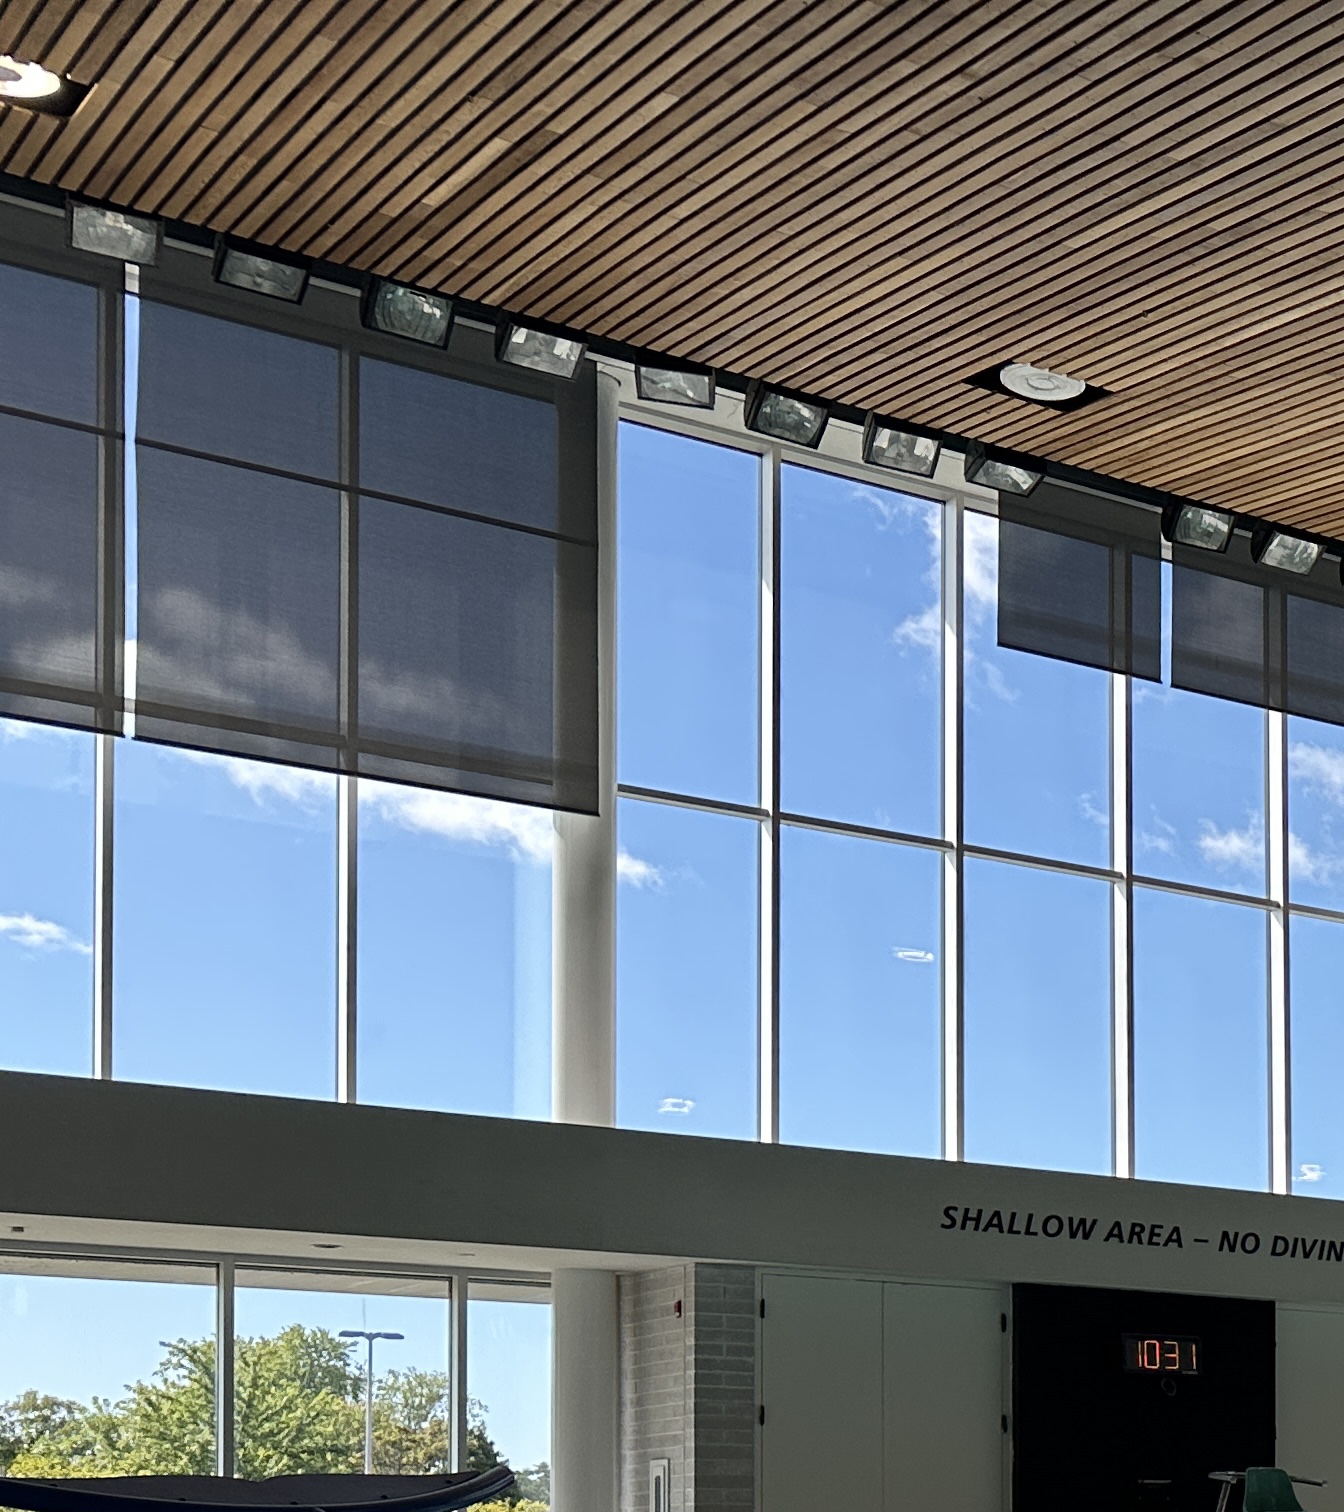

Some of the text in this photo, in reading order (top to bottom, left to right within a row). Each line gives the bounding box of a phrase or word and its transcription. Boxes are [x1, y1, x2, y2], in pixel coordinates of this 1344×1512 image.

[940, 1205, 1098, 1241] SHALLOW
[1103, 1220, 1183, 1249] AREA
[1218, 1230, 1261, 1255] NO
